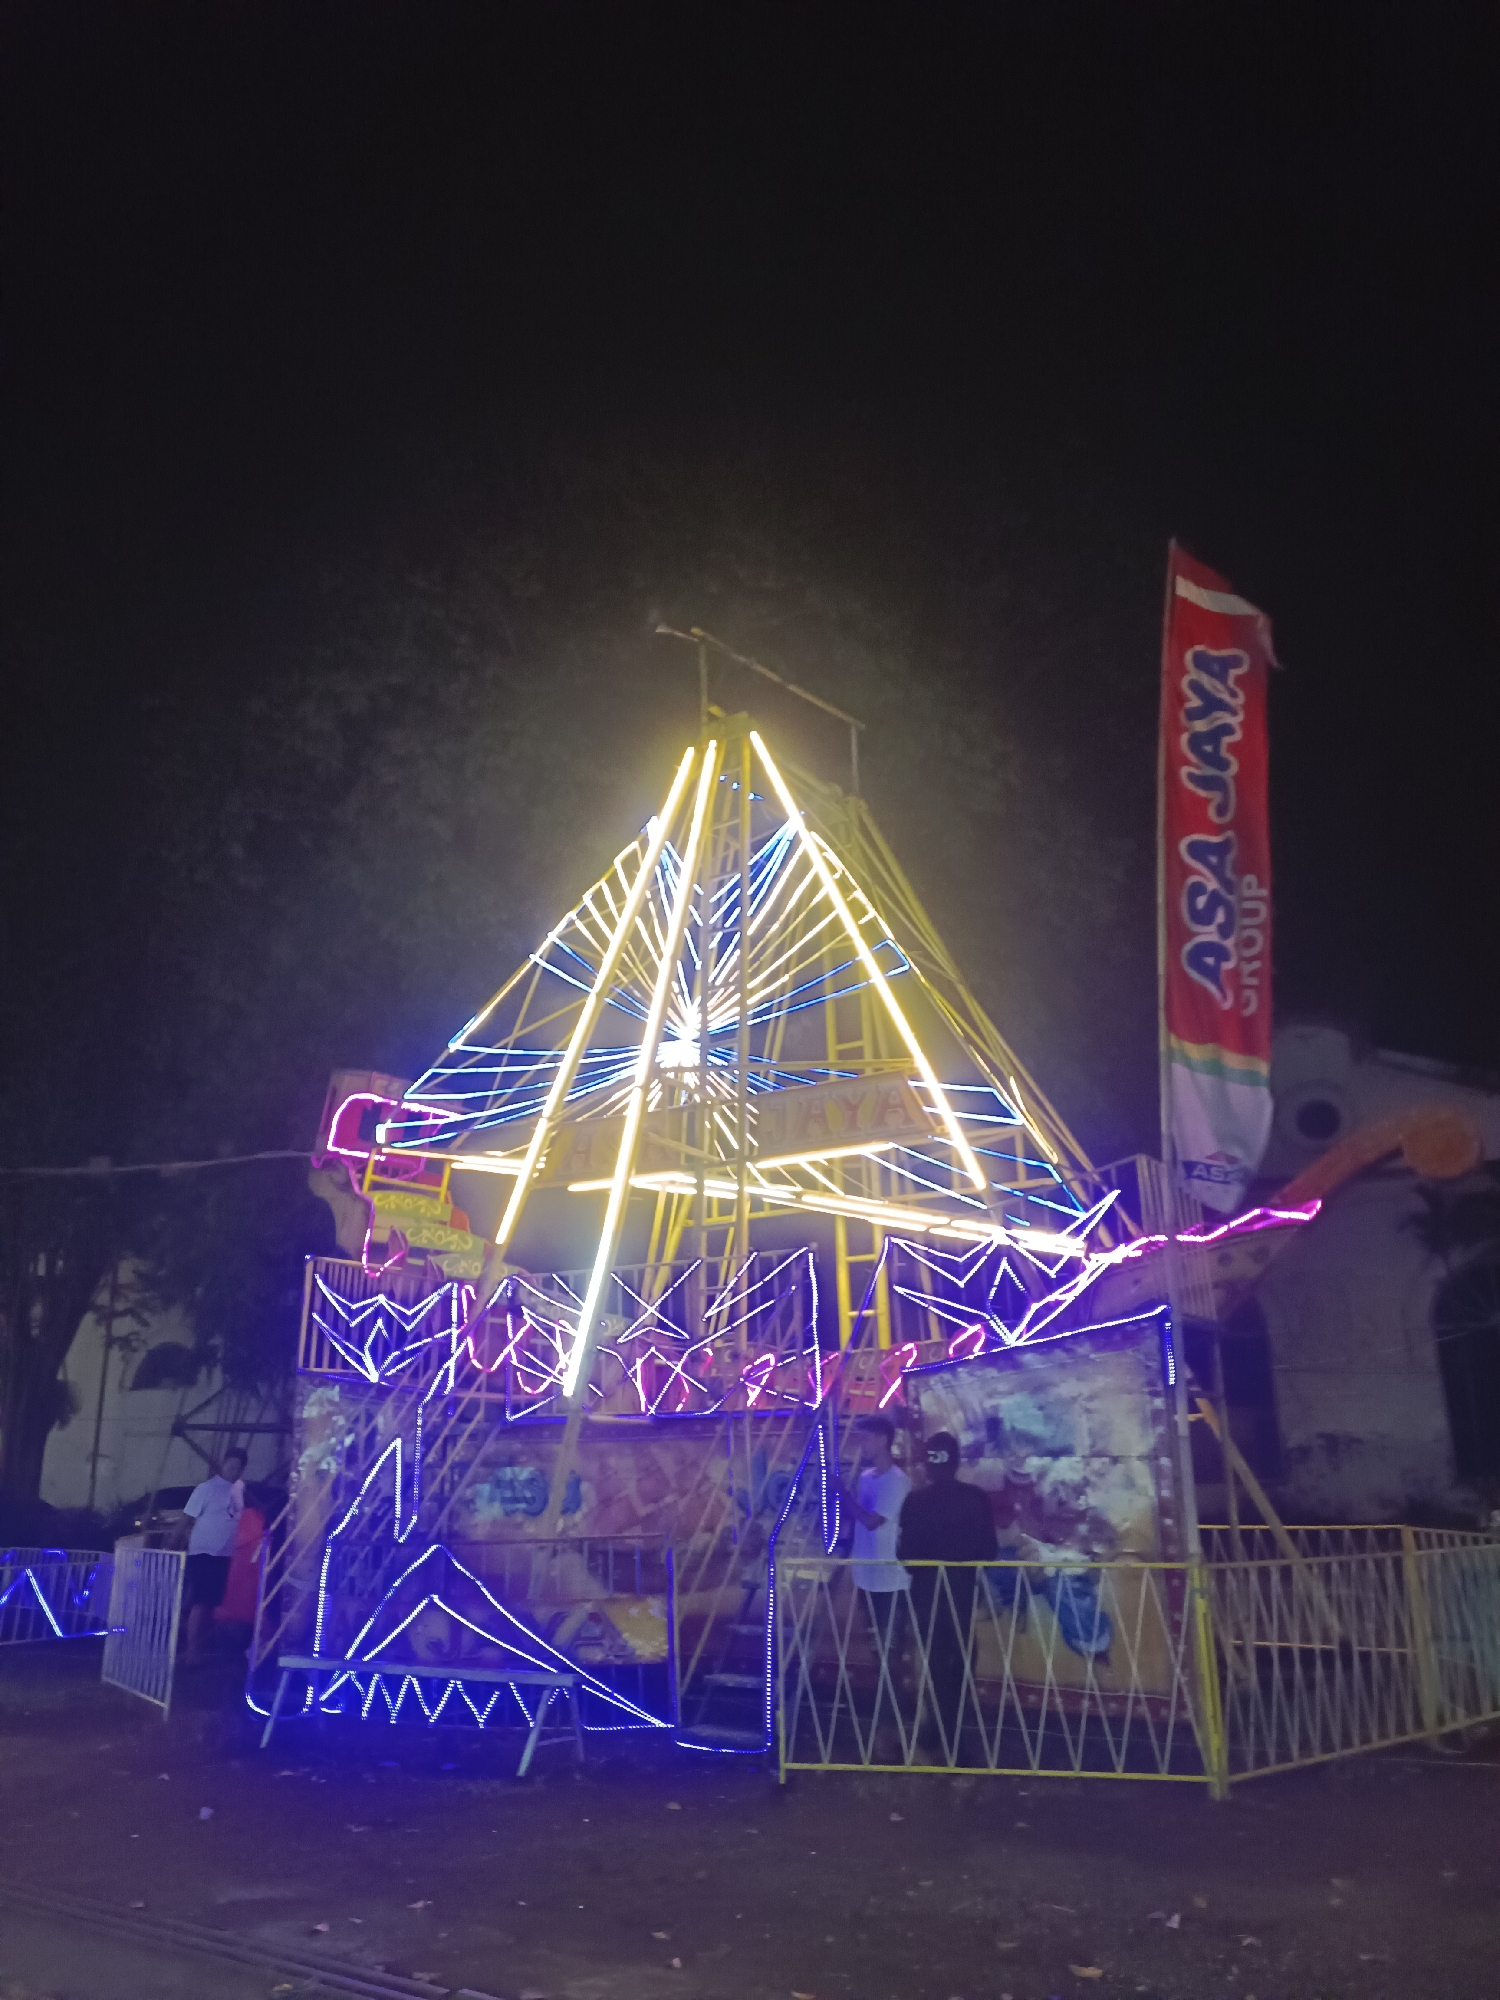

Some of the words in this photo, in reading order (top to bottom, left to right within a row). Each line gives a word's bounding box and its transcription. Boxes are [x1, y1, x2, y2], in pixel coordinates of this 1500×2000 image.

[1181, 645, 1250, 824] JAYA
[1179, 830, 1239, 1010] ASA
[760, 1081, 918, 1145] JAYA
